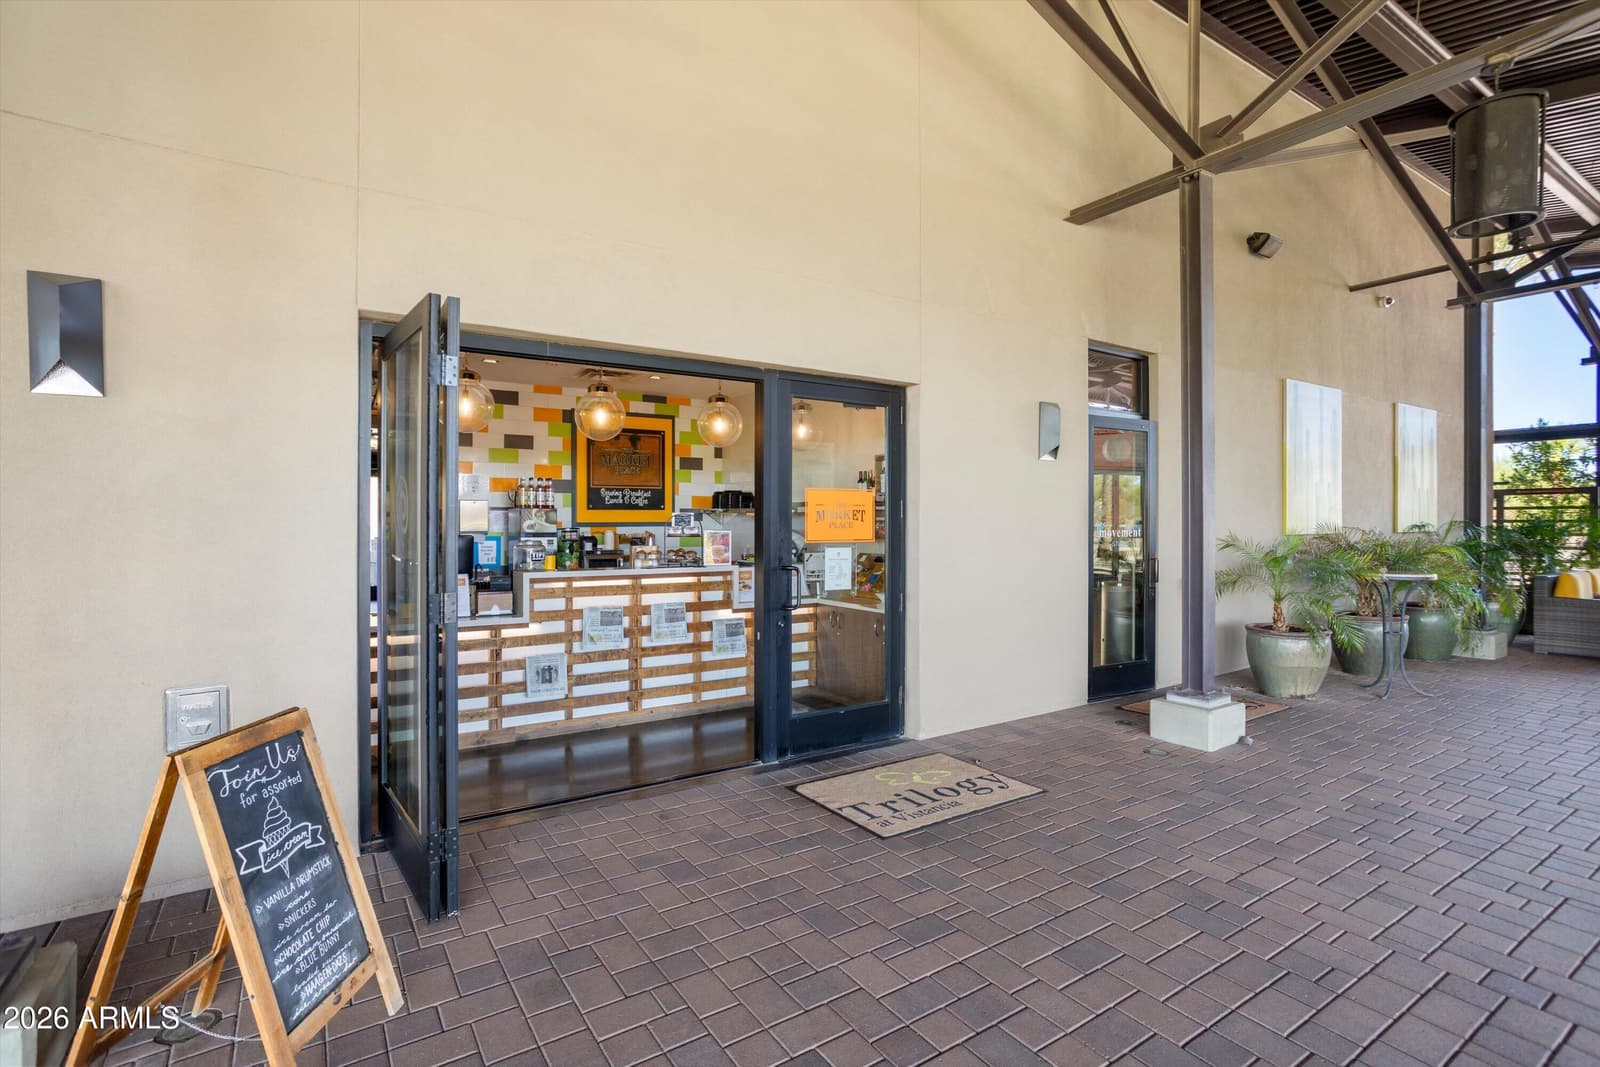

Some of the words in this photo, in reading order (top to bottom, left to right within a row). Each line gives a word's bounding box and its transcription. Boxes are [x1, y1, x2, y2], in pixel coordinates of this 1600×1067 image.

[1100, 528, 1141, 538] movement
[207, 764, 268, 798] Join
[264, 742, 301, 770] Us
[240, 792, 258, 809] for
[261, 770, 303, 798] assorted
[838, 773, 1010, 821] Trilogy
[876, 817, 895, 828] at
[897, 799, 963, 823] Vistancia
[264, 848, 283, 867] ice
[283, 830, 309, 852] cream
[263, 882, 296, 910] VANILLA
[296, 855, 332, 888] DRUMSTICK
[284, 897, 318, 928] SNICKERS
[279, 927, 315, 963] CHOCOLATE
[315, 914, 331, 934] CHIP
[300, 950, 319, 973] BLUE
[319, 931, 341, 957] BUNNY
